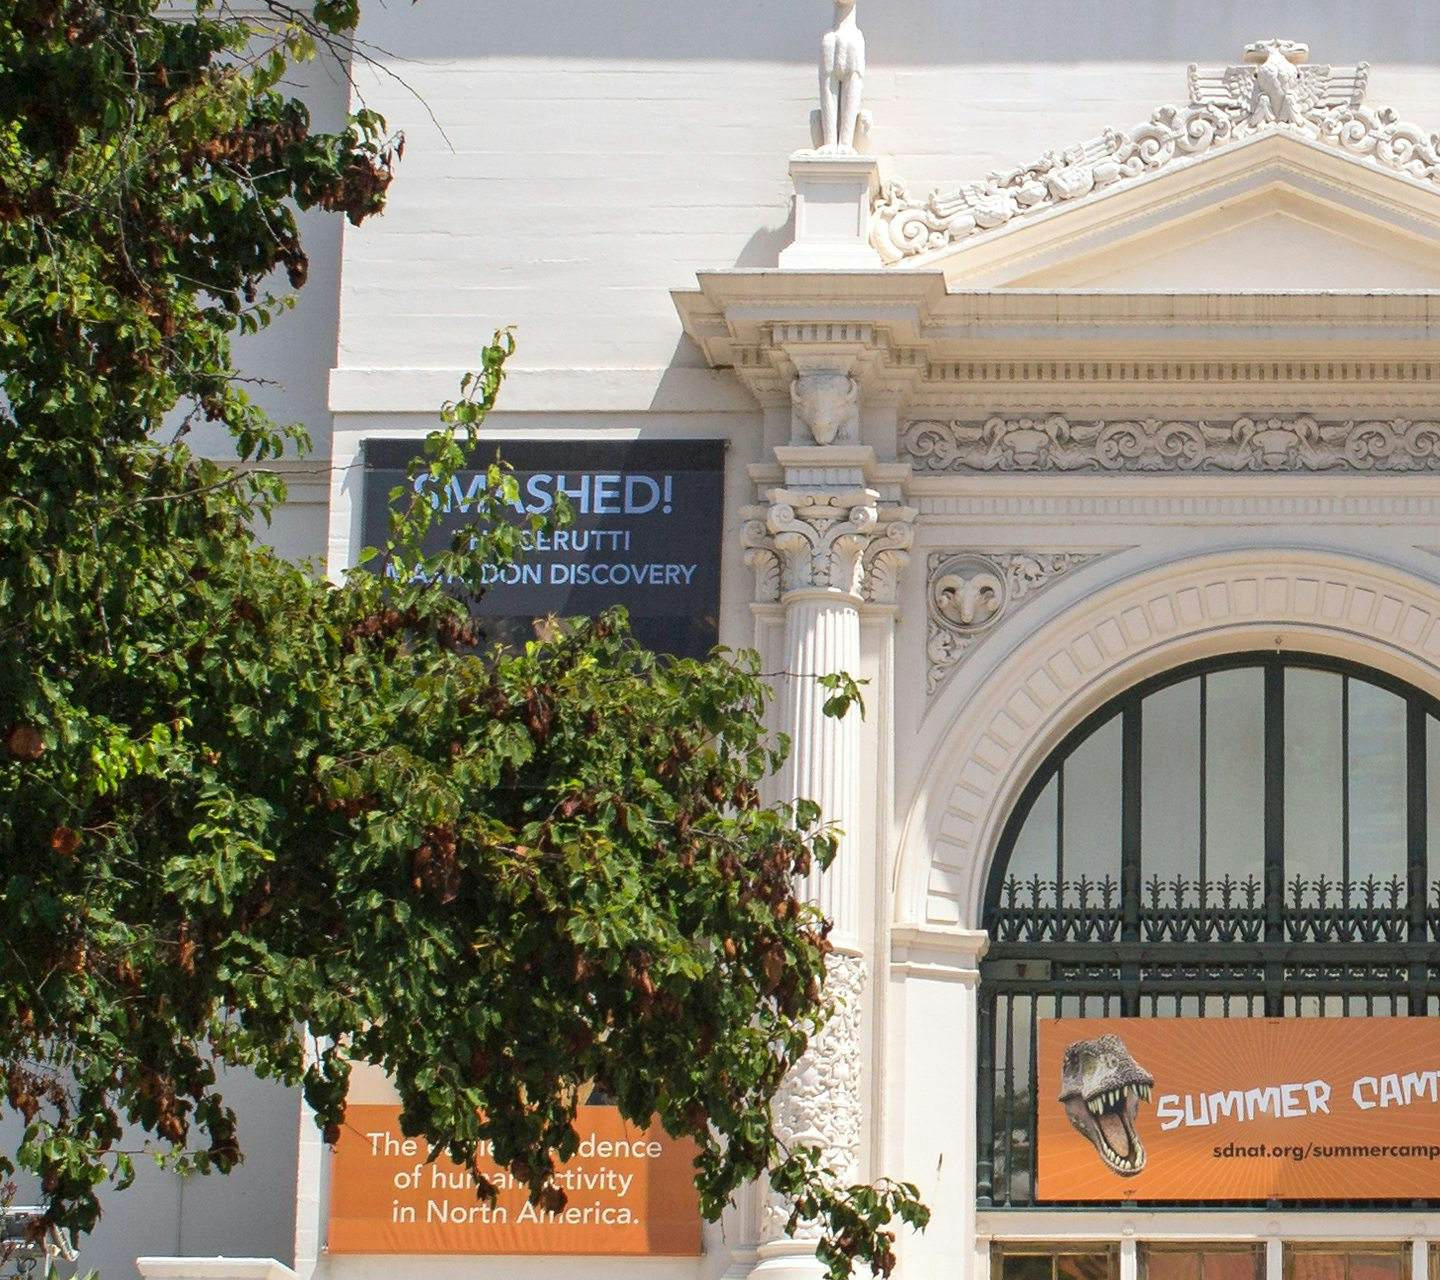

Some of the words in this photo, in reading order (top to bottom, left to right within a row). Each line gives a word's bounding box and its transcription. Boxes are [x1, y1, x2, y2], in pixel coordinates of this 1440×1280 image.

[550, 563, 698, 585] DISCOVERY
[1156, 1080, 1332, 1132] SUMMER
[366, 1132, 417, 1157] The
[539, 1132, 663, 1158] dence
[1212, 1141, 1440, 1161] sdnat.org/summercamp
[393, 1164, 423, 1189] of
[391, 1199, 416, 1223] in
[426, 1199, 508, 1224] North
